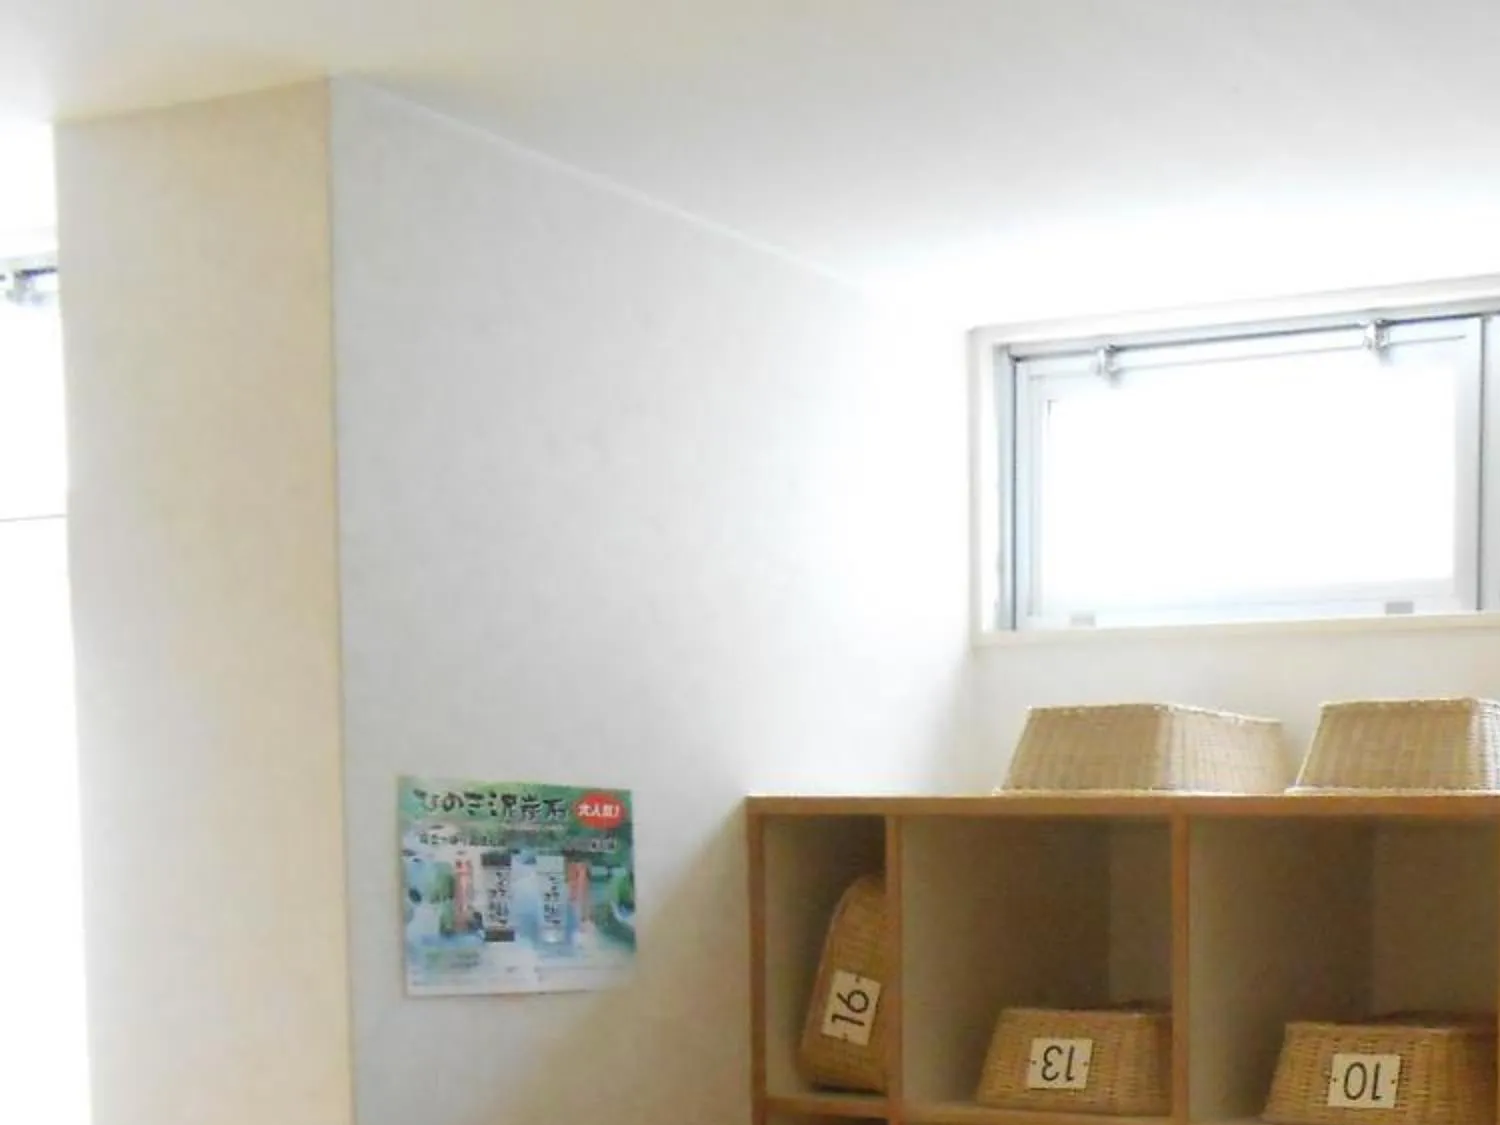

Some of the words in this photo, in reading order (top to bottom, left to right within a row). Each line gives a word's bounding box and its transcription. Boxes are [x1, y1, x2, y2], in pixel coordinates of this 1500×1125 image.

[831, 988, 869, 1027] 16
[1041, 1045, 1075, 1083] 13
[1343, 1061, 1382, 1101] 10
